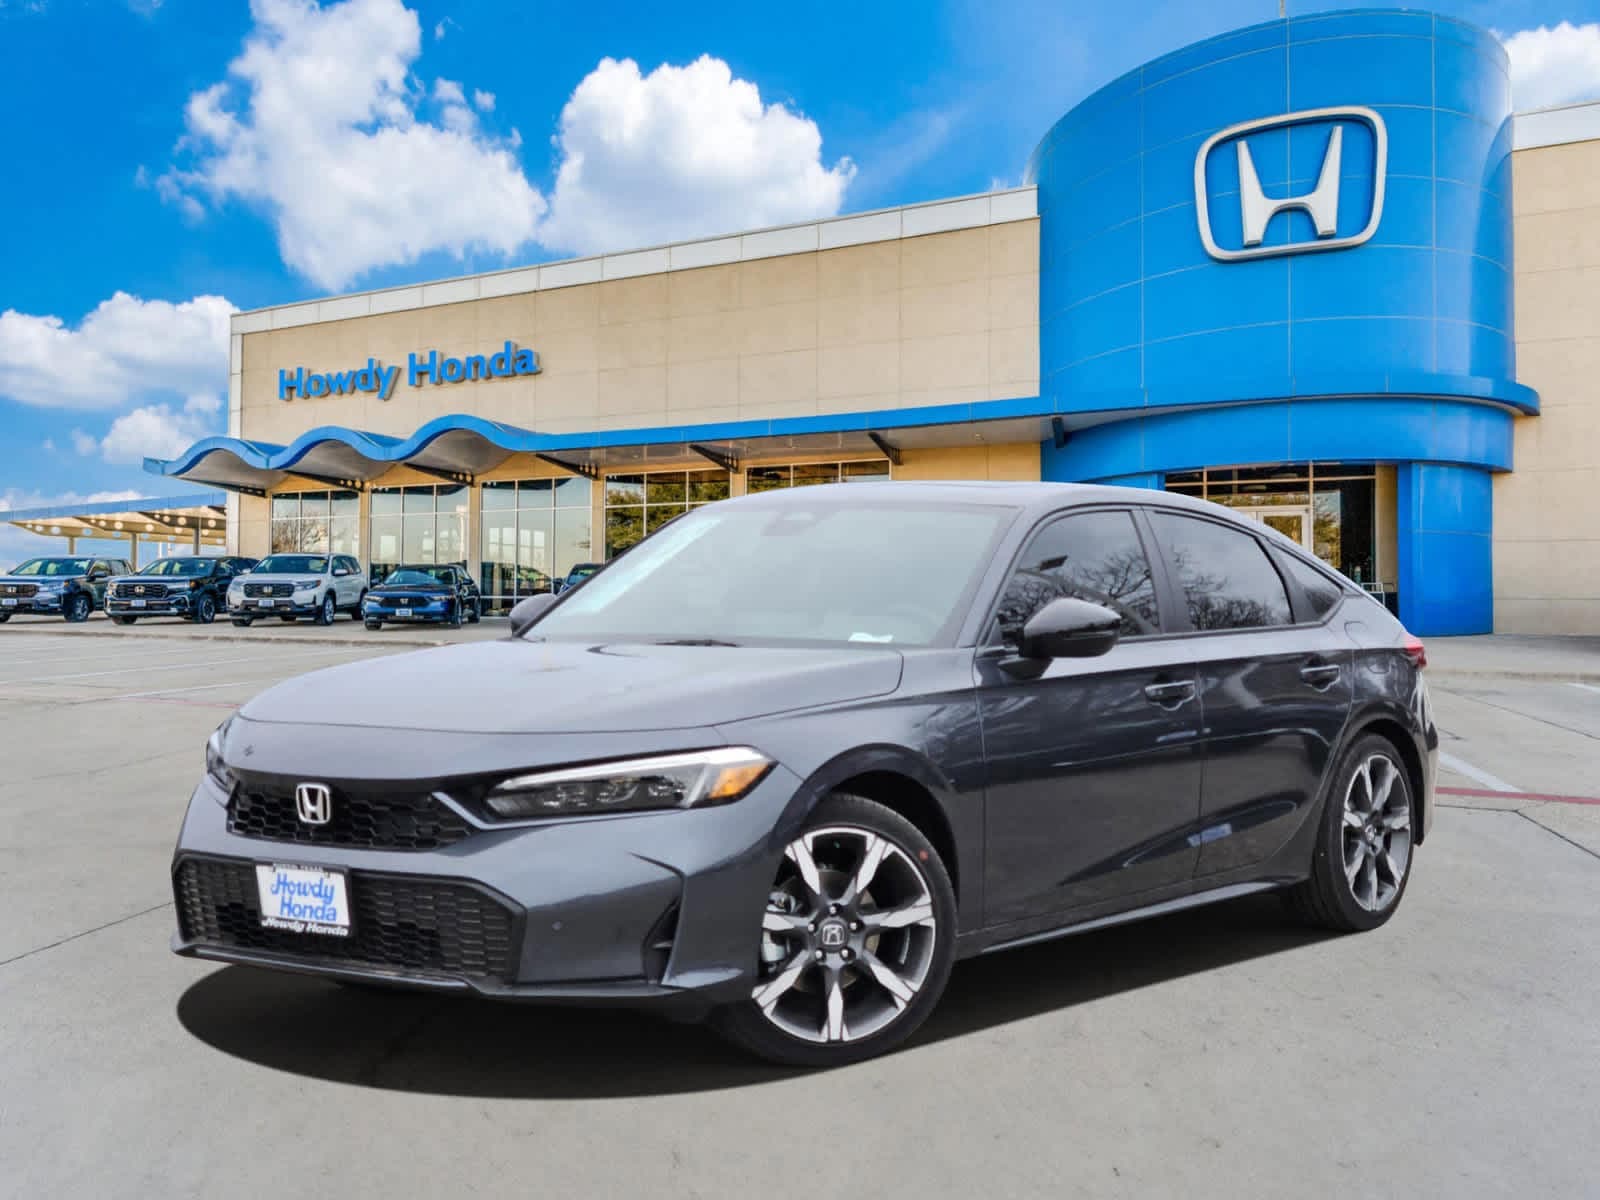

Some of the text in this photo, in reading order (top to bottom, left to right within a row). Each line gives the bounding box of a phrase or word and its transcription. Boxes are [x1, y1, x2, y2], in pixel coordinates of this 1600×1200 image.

[279, 340, 540, 401] Howdy Honda
[271, 872, 335, 905] Howdy
[280, 896, 337, 922] Honda
